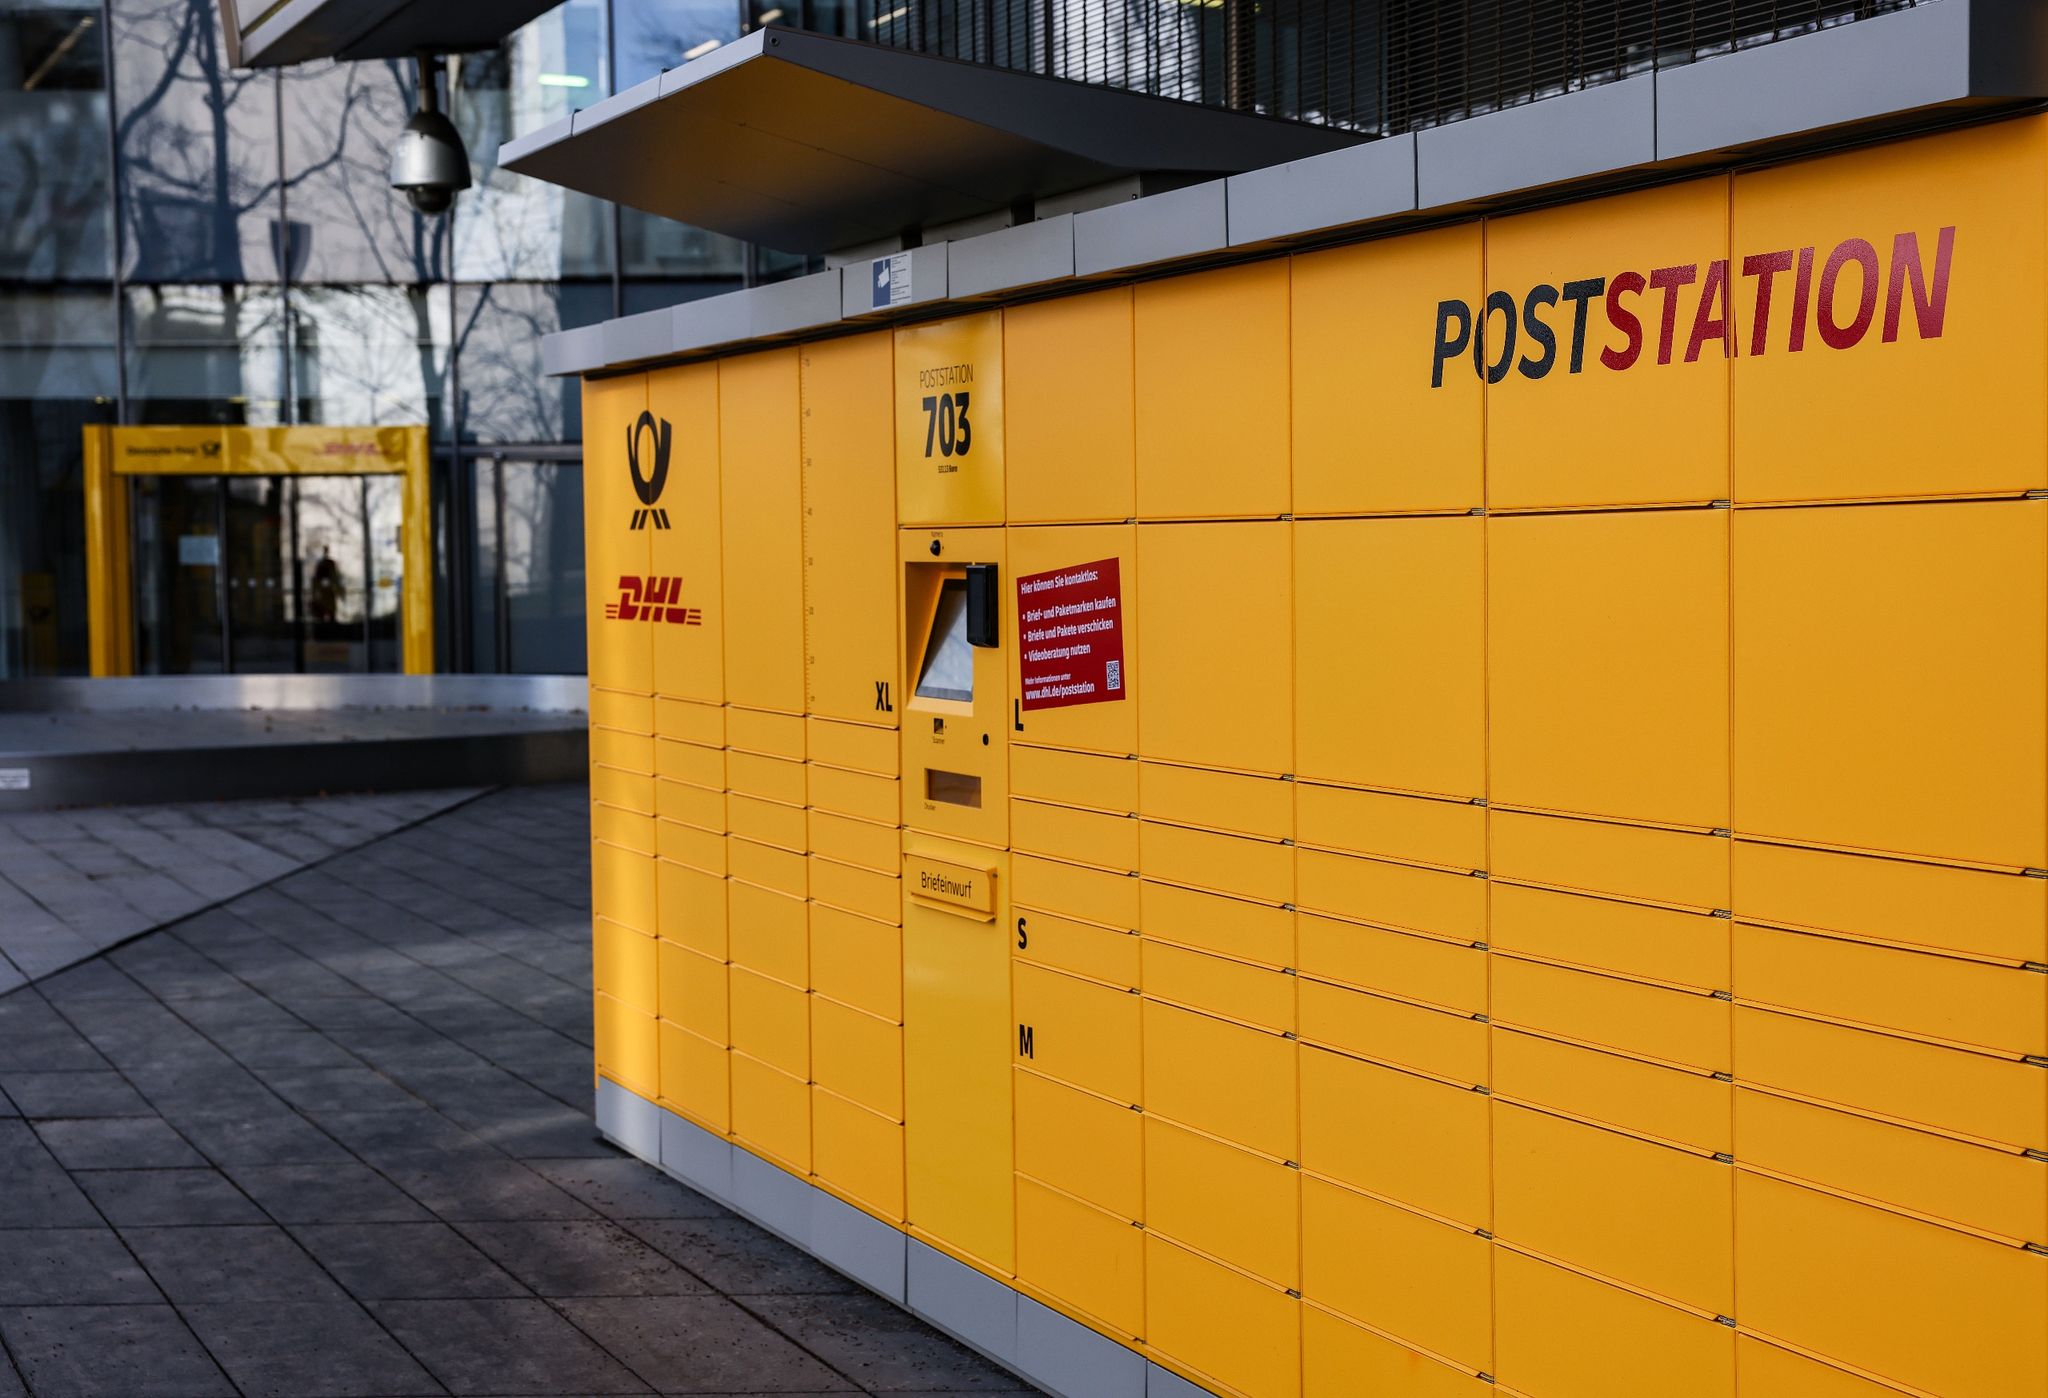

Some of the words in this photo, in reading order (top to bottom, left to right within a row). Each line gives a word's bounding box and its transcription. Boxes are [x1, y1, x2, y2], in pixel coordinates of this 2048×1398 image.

[1431, 226, 1956, 388] POSTSTATION
[920, 364, 973, 388] POSTSTATION
[922, 392, 971, 458] 703
[1021, 582, 1033, 595] Hier
[1033, 579, 1054, 592] können
[1055, 576, 1064, 588] Sie
[1064, 570, 1098, 586] kontaktlos:
[617, 576, 688, 624] DHL
[1027, 608, 1043, 622] Brief-
[1043, 605, 1054, 619] und
[1055, 600, 1094, 617] Paketmarken
[1094, 596, 1116, 610] kaufen
[1027, 628, 1045, 642] Briefe
[1045, 626, 1057, 639] und
[1057, 624, 1077, 637] Pakete
[1077, 618, 1114, 634] verschicken
[1028, 648, 1070, 662] Videoberatung
[1070, 644, 1091, 656] nutzen
[875, 681, 893, 712] XL
[1025, 680, 1095, 700] www.dhl.de/poststation
[1015, 698, 1024, 732] L
[921, 871, 972, 899] Briefeinwurf
[1017, 917, 1028, 950] S
[1019, 1023, 1034, 1060] M
